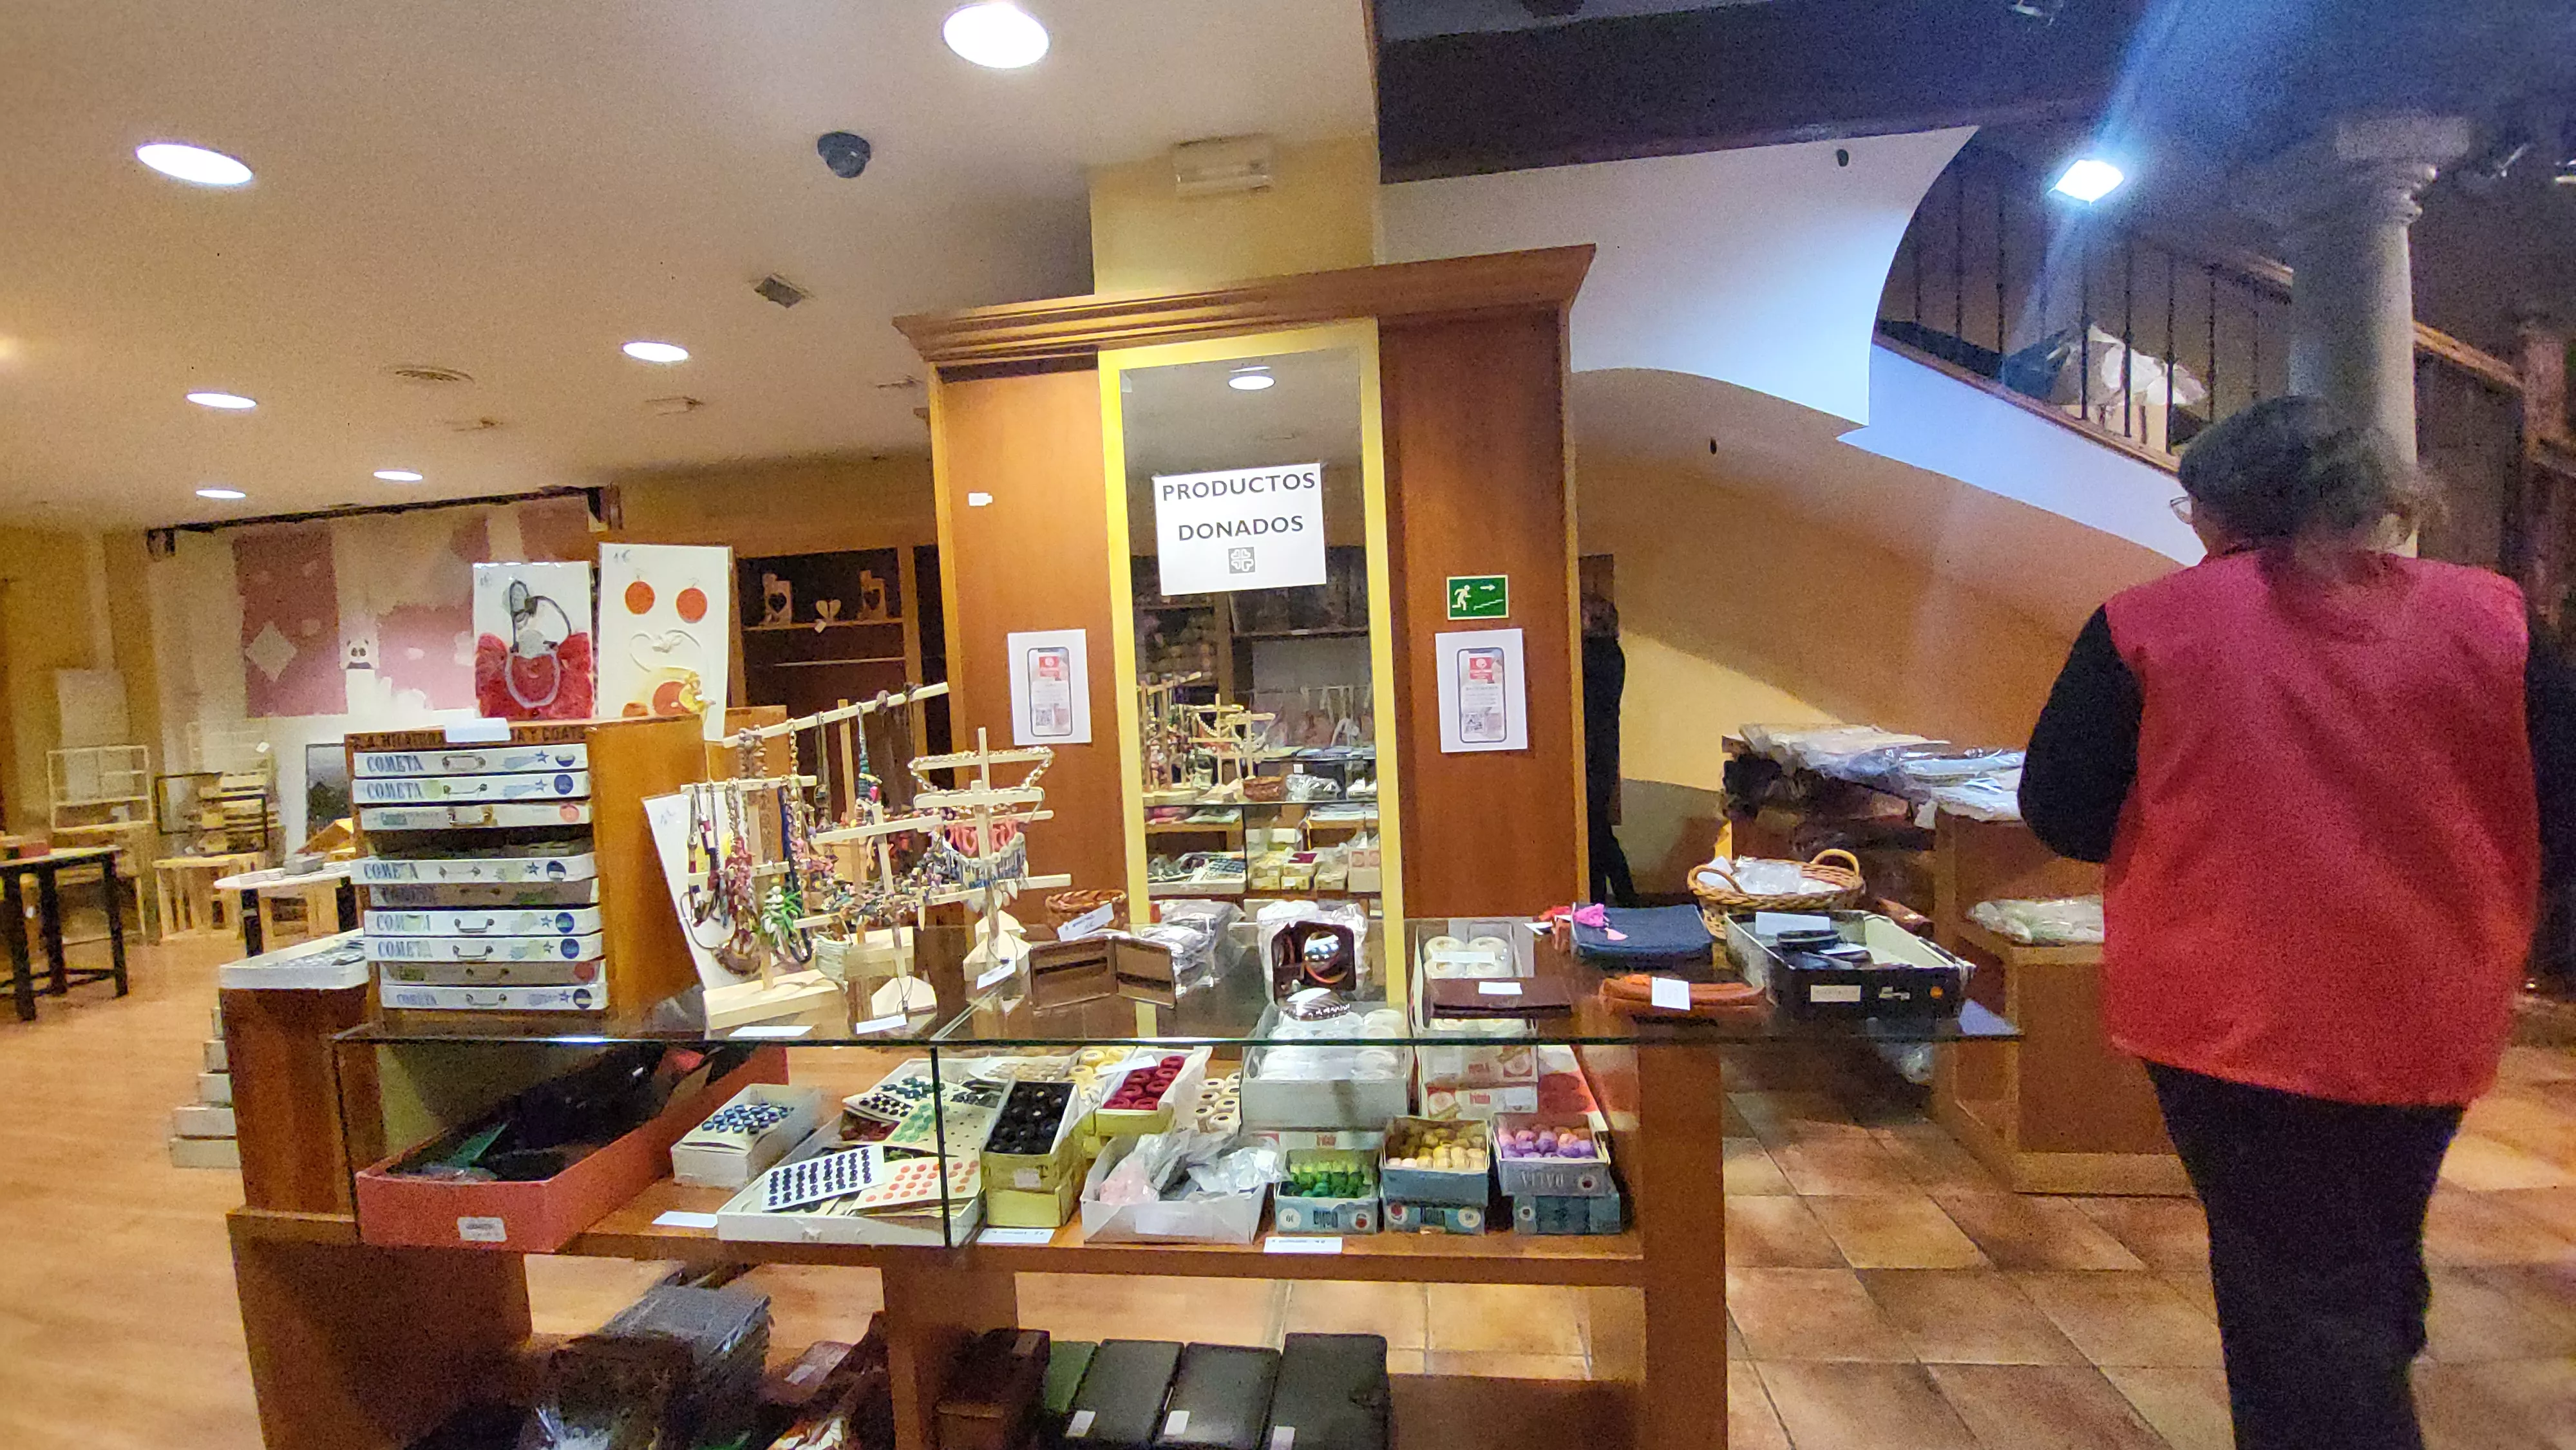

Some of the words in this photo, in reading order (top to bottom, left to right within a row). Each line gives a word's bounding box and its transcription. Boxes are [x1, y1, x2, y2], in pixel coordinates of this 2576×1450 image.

[1162, 472, 1315, 501] PRODUCTOS
[1179, 515, 1303, 541] DONADOS
[367, 755, 424, 773] COMETA
[367, 782, 425, 800] COMETA
[364, 863, 419, 880] COMEA
[377, 914, 431, 932] COMA
